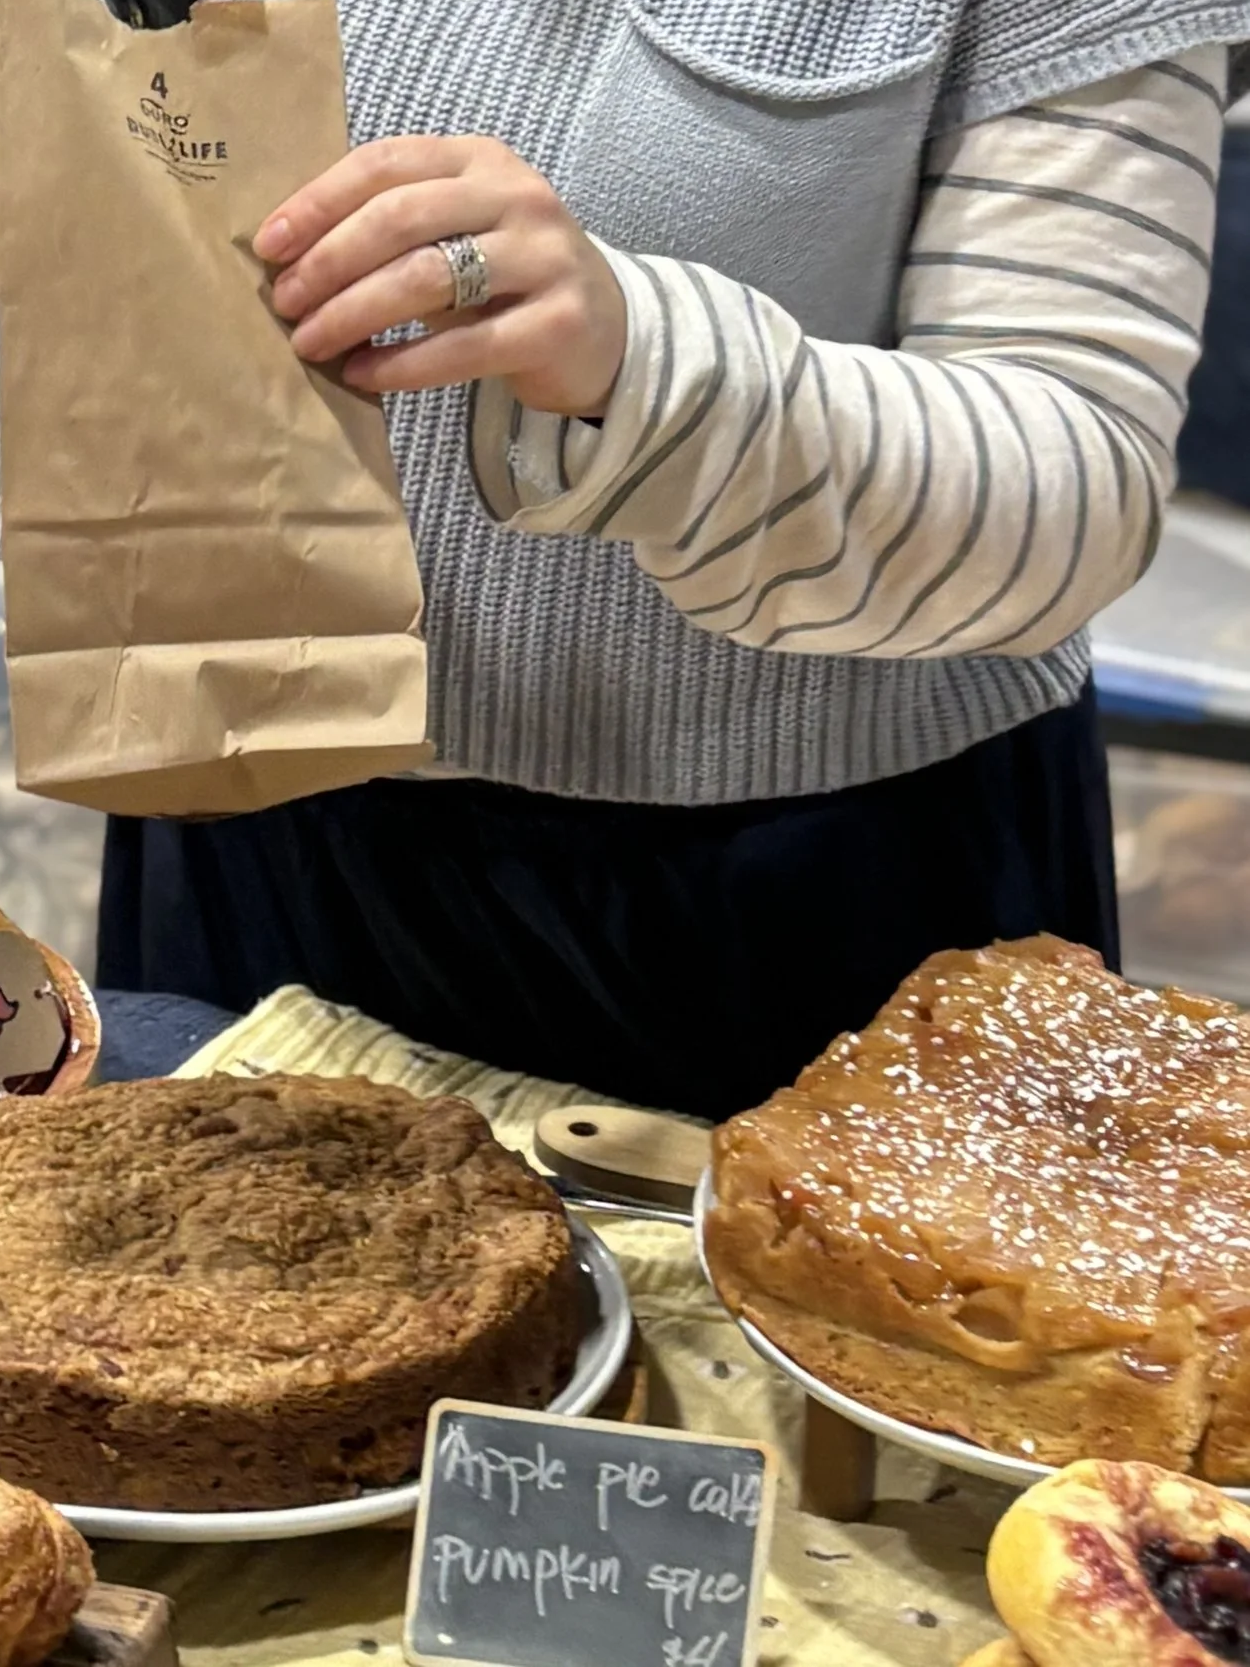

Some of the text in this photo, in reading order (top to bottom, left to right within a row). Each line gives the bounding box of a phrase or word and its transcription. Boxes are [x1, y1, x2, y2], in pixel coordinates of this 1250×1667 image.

[150, 71, 168, 100] 4
[178, 140, 228, 160] LIFE
[439, 1422, 567, 1516] Apple
[646, 1562, 746, 1629] spice
